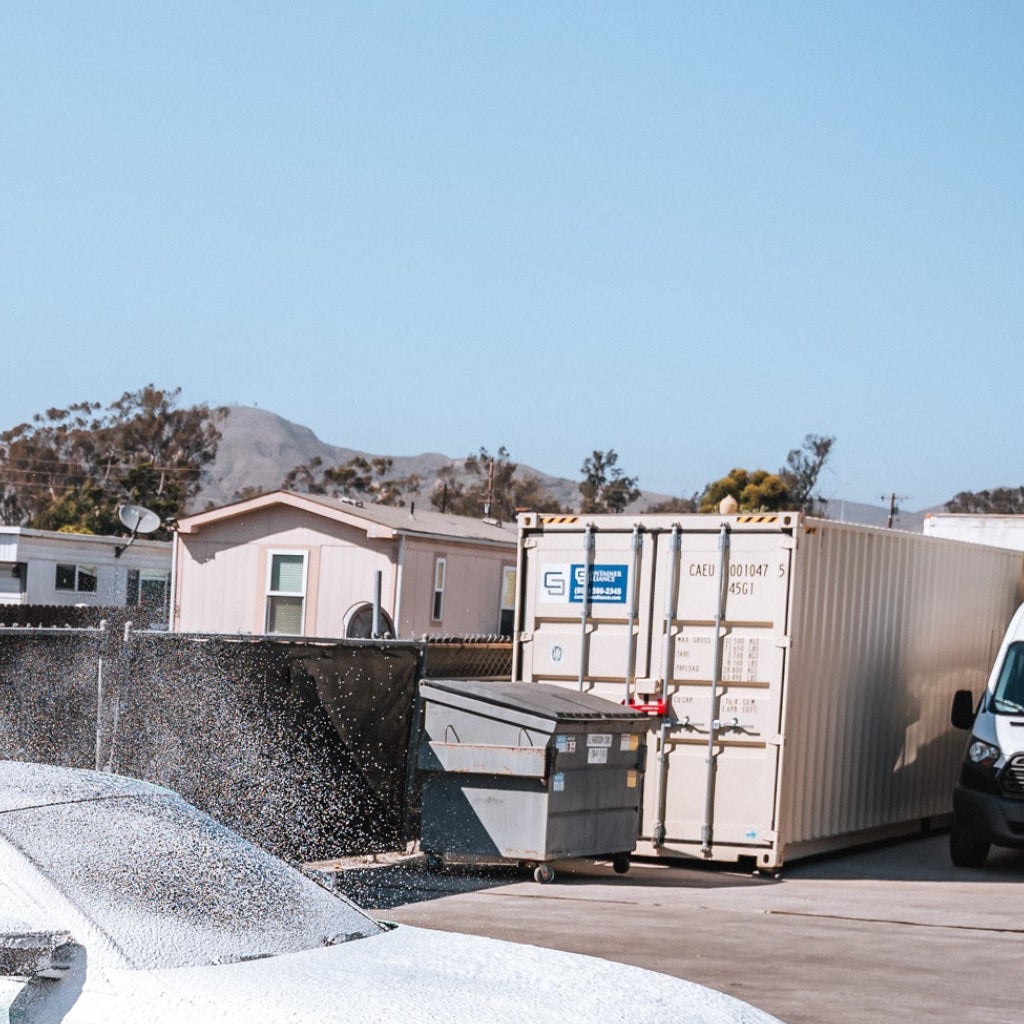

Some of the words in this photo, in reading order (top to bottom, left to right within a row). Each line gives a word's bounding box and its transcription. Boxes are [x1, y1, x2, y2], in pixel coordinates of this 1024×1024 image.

[689, 564, 715, 577] CAEU
[729, 564, 769, 578] 001047
[778, 564, 785, 577] 5
[728, 582, 754, 595] 45G1
[676, 664, 700, 673] PAYLOAD
